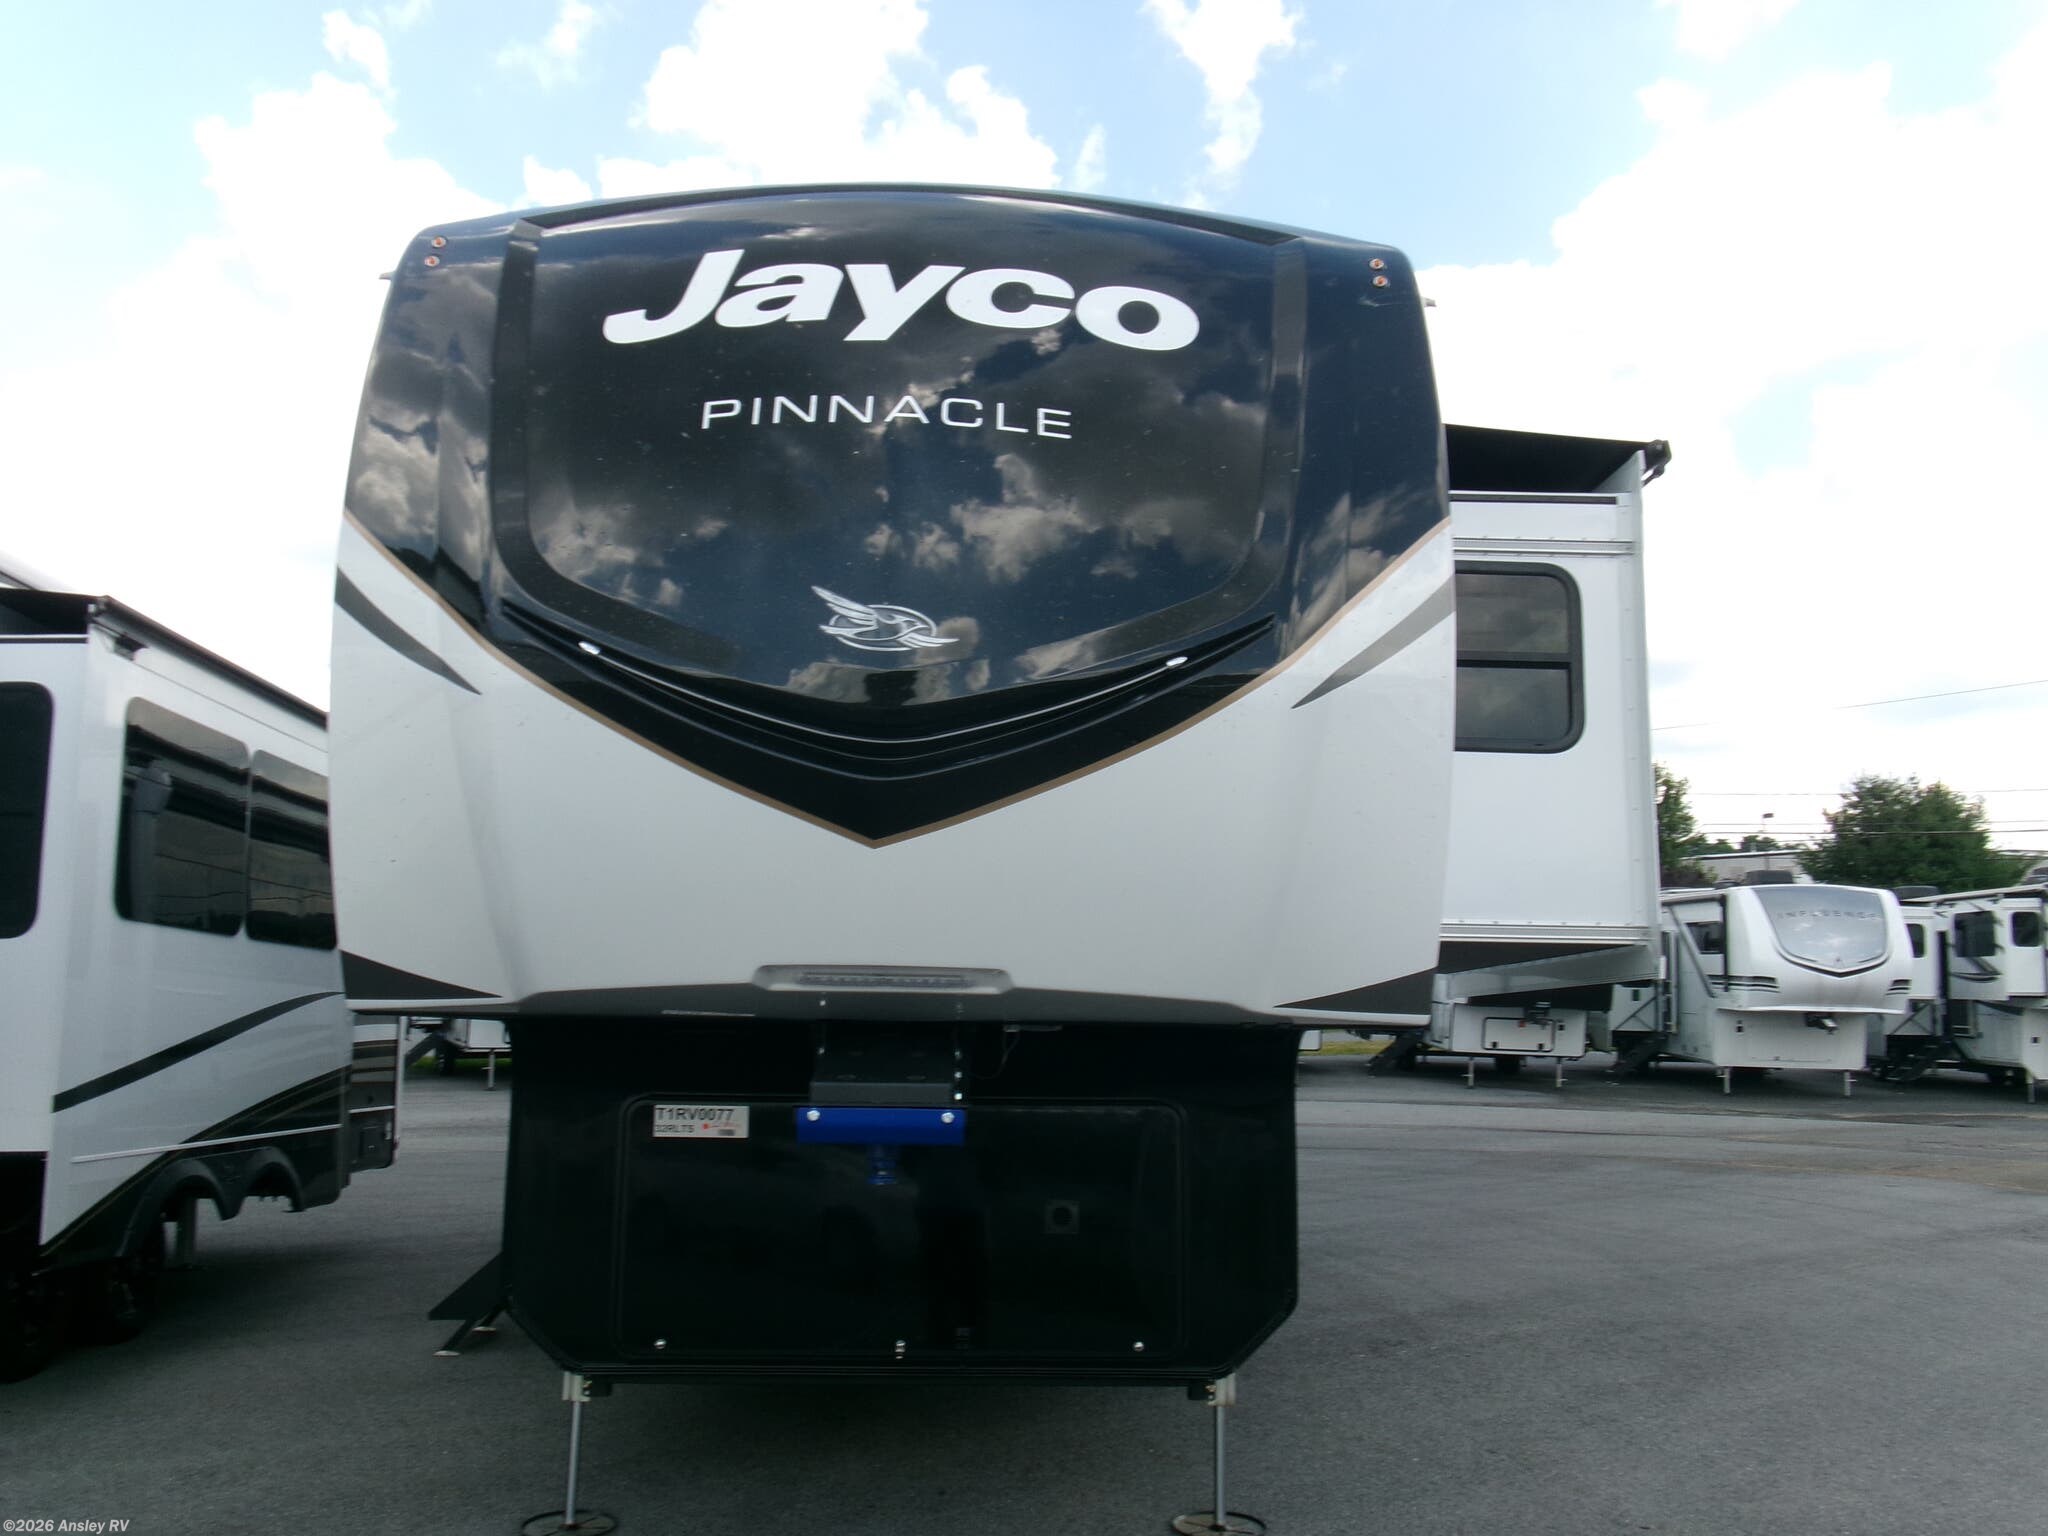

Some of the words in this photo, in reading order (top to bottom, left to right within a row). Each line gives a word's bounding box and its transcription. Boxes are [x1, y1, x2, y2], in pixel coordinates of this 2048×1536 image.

[602, 248, 1201, 352] Jayco
[701, 395, 1073, 440] PINNACLE
[655, 1107, 735, 1121] T1RV0077
